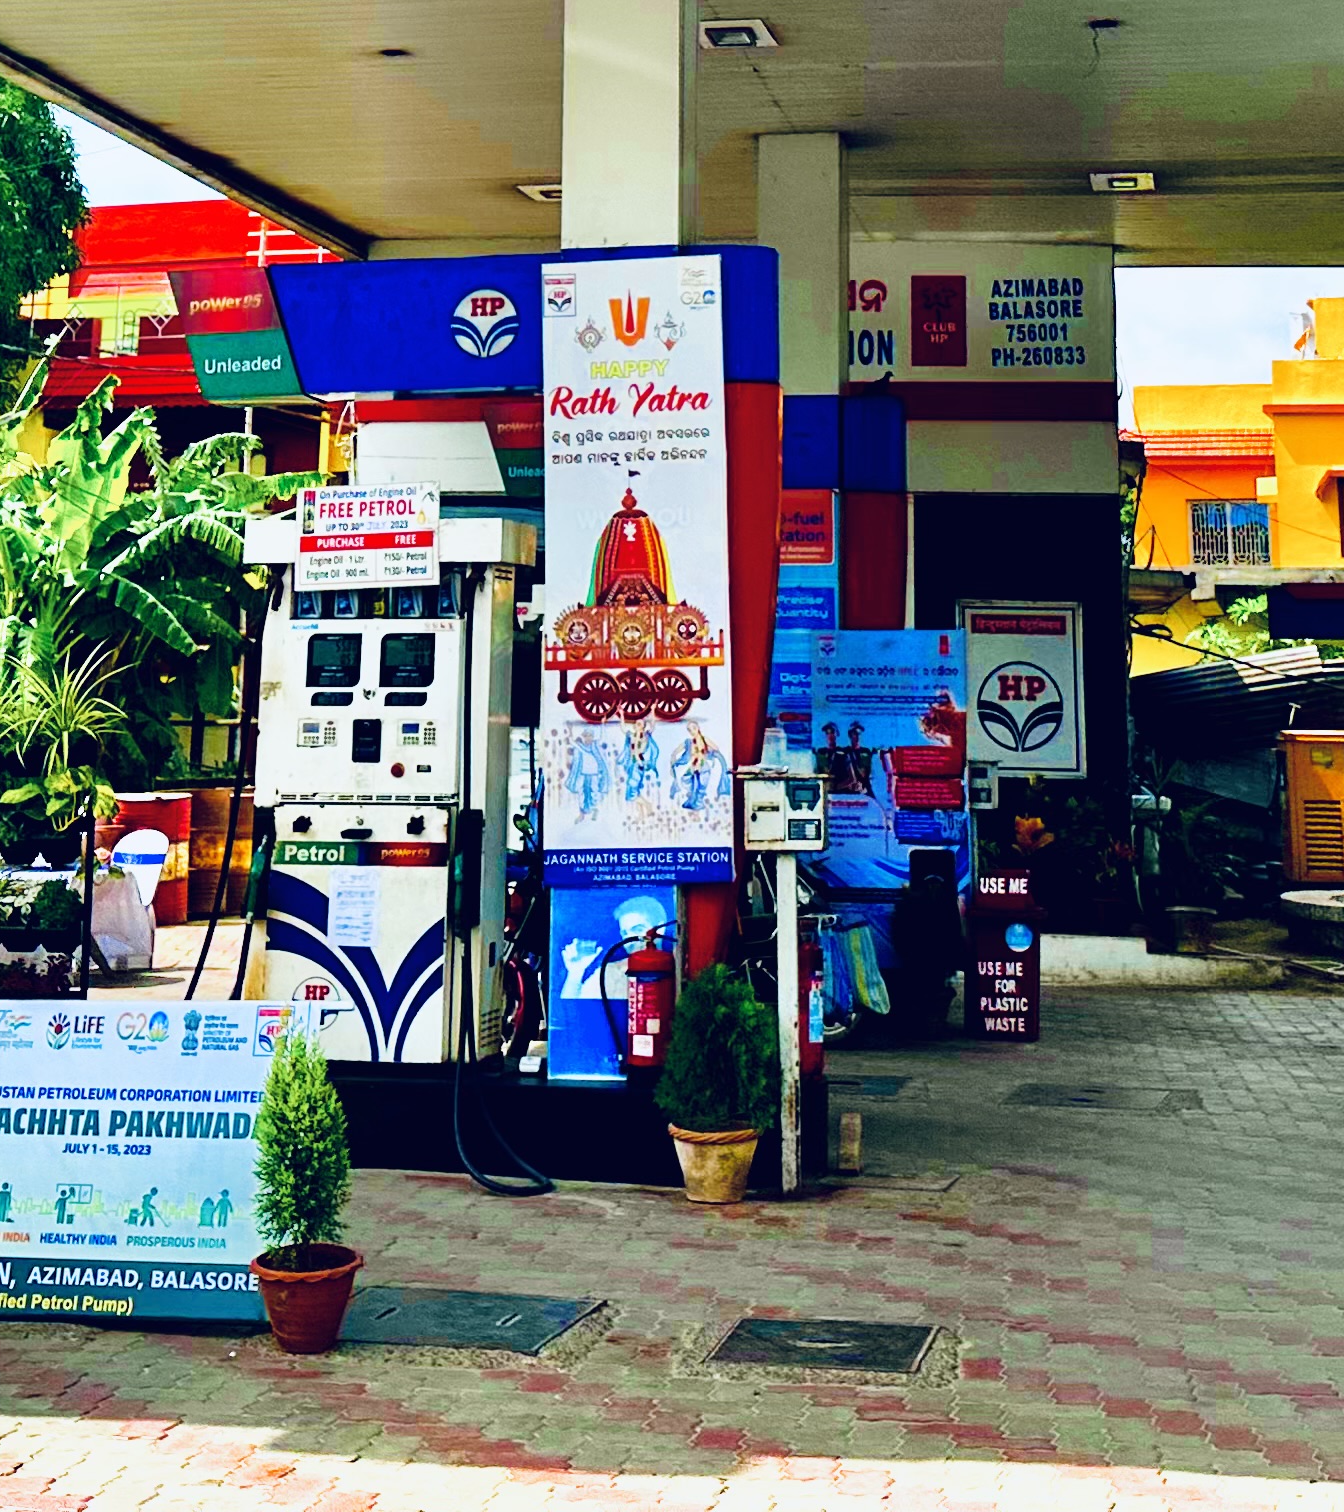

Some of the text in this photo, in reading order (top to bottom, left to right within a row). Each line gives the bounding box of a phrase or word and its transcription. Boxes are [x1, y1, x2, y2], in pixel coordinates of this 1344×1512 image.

[991, 277, 1084, 299] AZIMABAD
[470, 296, 506, 318] HP
[988, 299, 1083, 321] BALASORE
[923, 322, 956, 333] CLUB
[1006, 322, 1068, 343] 756001
[930, 333, 948, 344] HP
[204, 355, 282, 375] Unleaded
[991, 345, 1086, 368] PH-260833
[590, 359, 670, 380] HAPPY
[549, 382, 714, 420] Rath Yatra
[378, 487, 404, 499] Engine
[405, 486, 417, 497] Oil
[319, 499, 416, 520] FREE PETROL
[316, 534, 417, 549] PURCHASE FREE
[406, 551, 427, 561] Petrol
[406, 565, 428, 575] Petrol
[997, 675, 1047, 701] HP
[284, 844, 345, 862] Petrol
[543, 851, 729, 866] JAGANNATH SERVICE STATION
[979, 877, 1029, 895] USE ME
[977, 961, 1024, 977] USE ME
[304, 984, 331, 1001] HP
[994, 979, 1017, 994] FOR
[980, 997, 1029, 1012] PLASTIC
[74, 1015, 105, 1034] LiFE
[984, 1017, 1026, 1032] WASTE
[37, 1087, 118, 1102] PETROLEUM
[119, 1088, 212, 1103] CORPORATION
[108, 1110, 260, 1140] PAKHWAD
[62, 1143, 89, 1155] JULY
[107, 1144, 121, 1157] 15,
[123, 1144, 152, 1156] 2023
[2, 1231, 31, 1243] INDIA
[39, 1233, 87, 1246] HEALTHY
[88, 1234, 117, 1246] INDIA
[126, 1235, 196, 1249] PROSPEROUS
[197, 1237, 227, 1250] INDIA
[26, 1266, 144, 1291] AZIMABAD,
[150, 1271, 260, 1292] BALASORE
[30, 1293, 79, 1312] Petrol
[81, 1295, 134, 1316] Pump)
